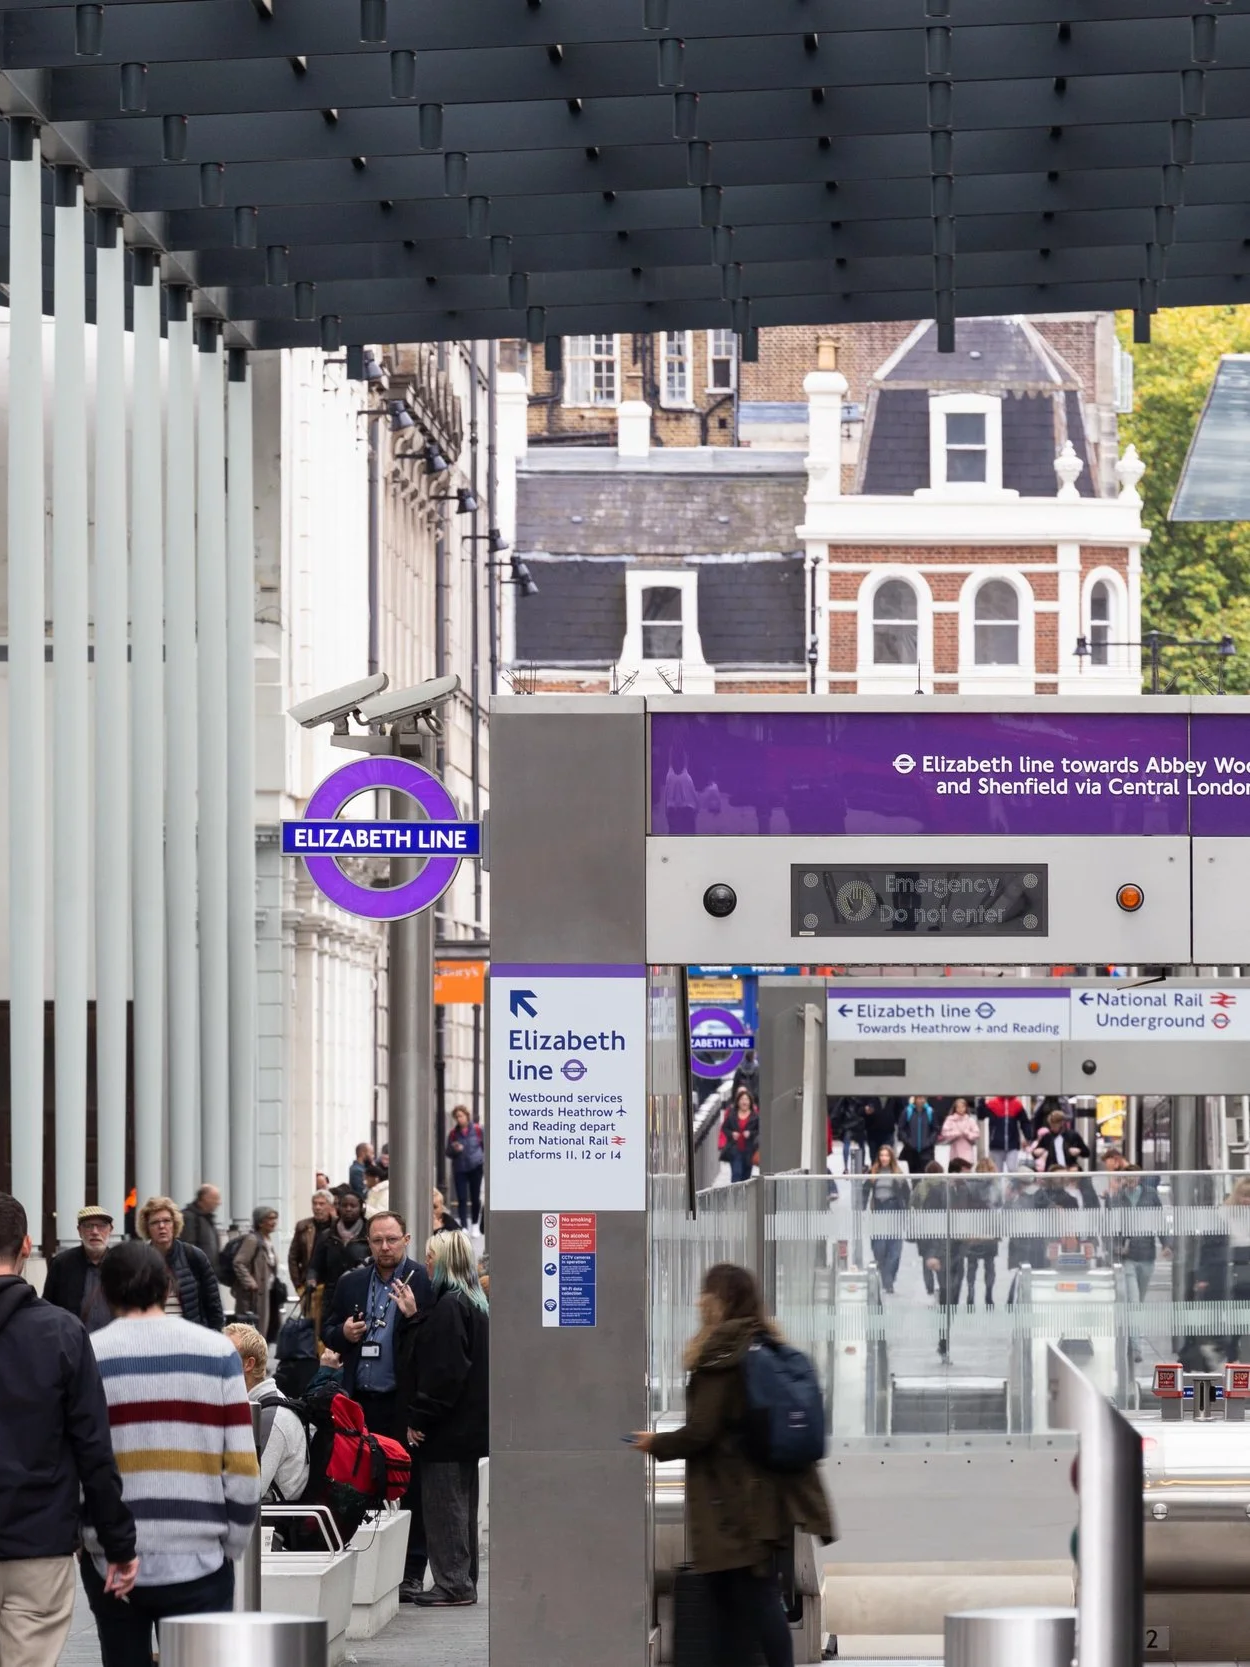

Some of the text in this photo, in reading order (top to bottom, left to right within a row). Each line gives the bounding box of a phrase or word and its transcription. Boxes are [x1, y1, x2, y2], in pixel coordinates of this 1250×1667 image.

[922, 755, 1013, 773] Elizabeth
[1019, 755, 1054, 773] line
[1061, 756, 1139, 774] towards
[1145, 756, 1207, 778] Abbey
[936, 777, 971, 795] and
[977, 777, 1068, 795] Shenfield
[1075, 778, 1102, 795] via
[1108, 778, 1180, 796] Central
[294, 828, 467, 849] ELIZABETH LINE
[885, 873, 1000, 899] Emergency
[879, 904, 1006, 923] Do not enter
[1096, 992, 1203, 1007] National Rail
[857, 1003, 971, 1018] Elizabeth line
[857, 1022, 1060, 1035] Towards Heathrow and Reading
[1096, 1013, 1205, 1031] Underground
[509, 1029, 626, 1051] Elizabeth
[691, 1038, 751, 1048] ZABETH LINE
[508, 1059, 553, 1081] line
[508, 1092, 623, 1103] Westbound services
[508, 1107, 613, 1117] towards Heathrow
[508, 1121, 616, 1133] and Reading depart
[508, 1135, 609, 1146] from National Rail
[508, 1149, 562, 1161] platforms
[581, 1150, 591, 1159] 12
[610, 1150, 622, 1159] 14
[1159, 1372, 1174, 1381] STOP
[1234, 1372, 1248, 1381] STOP
